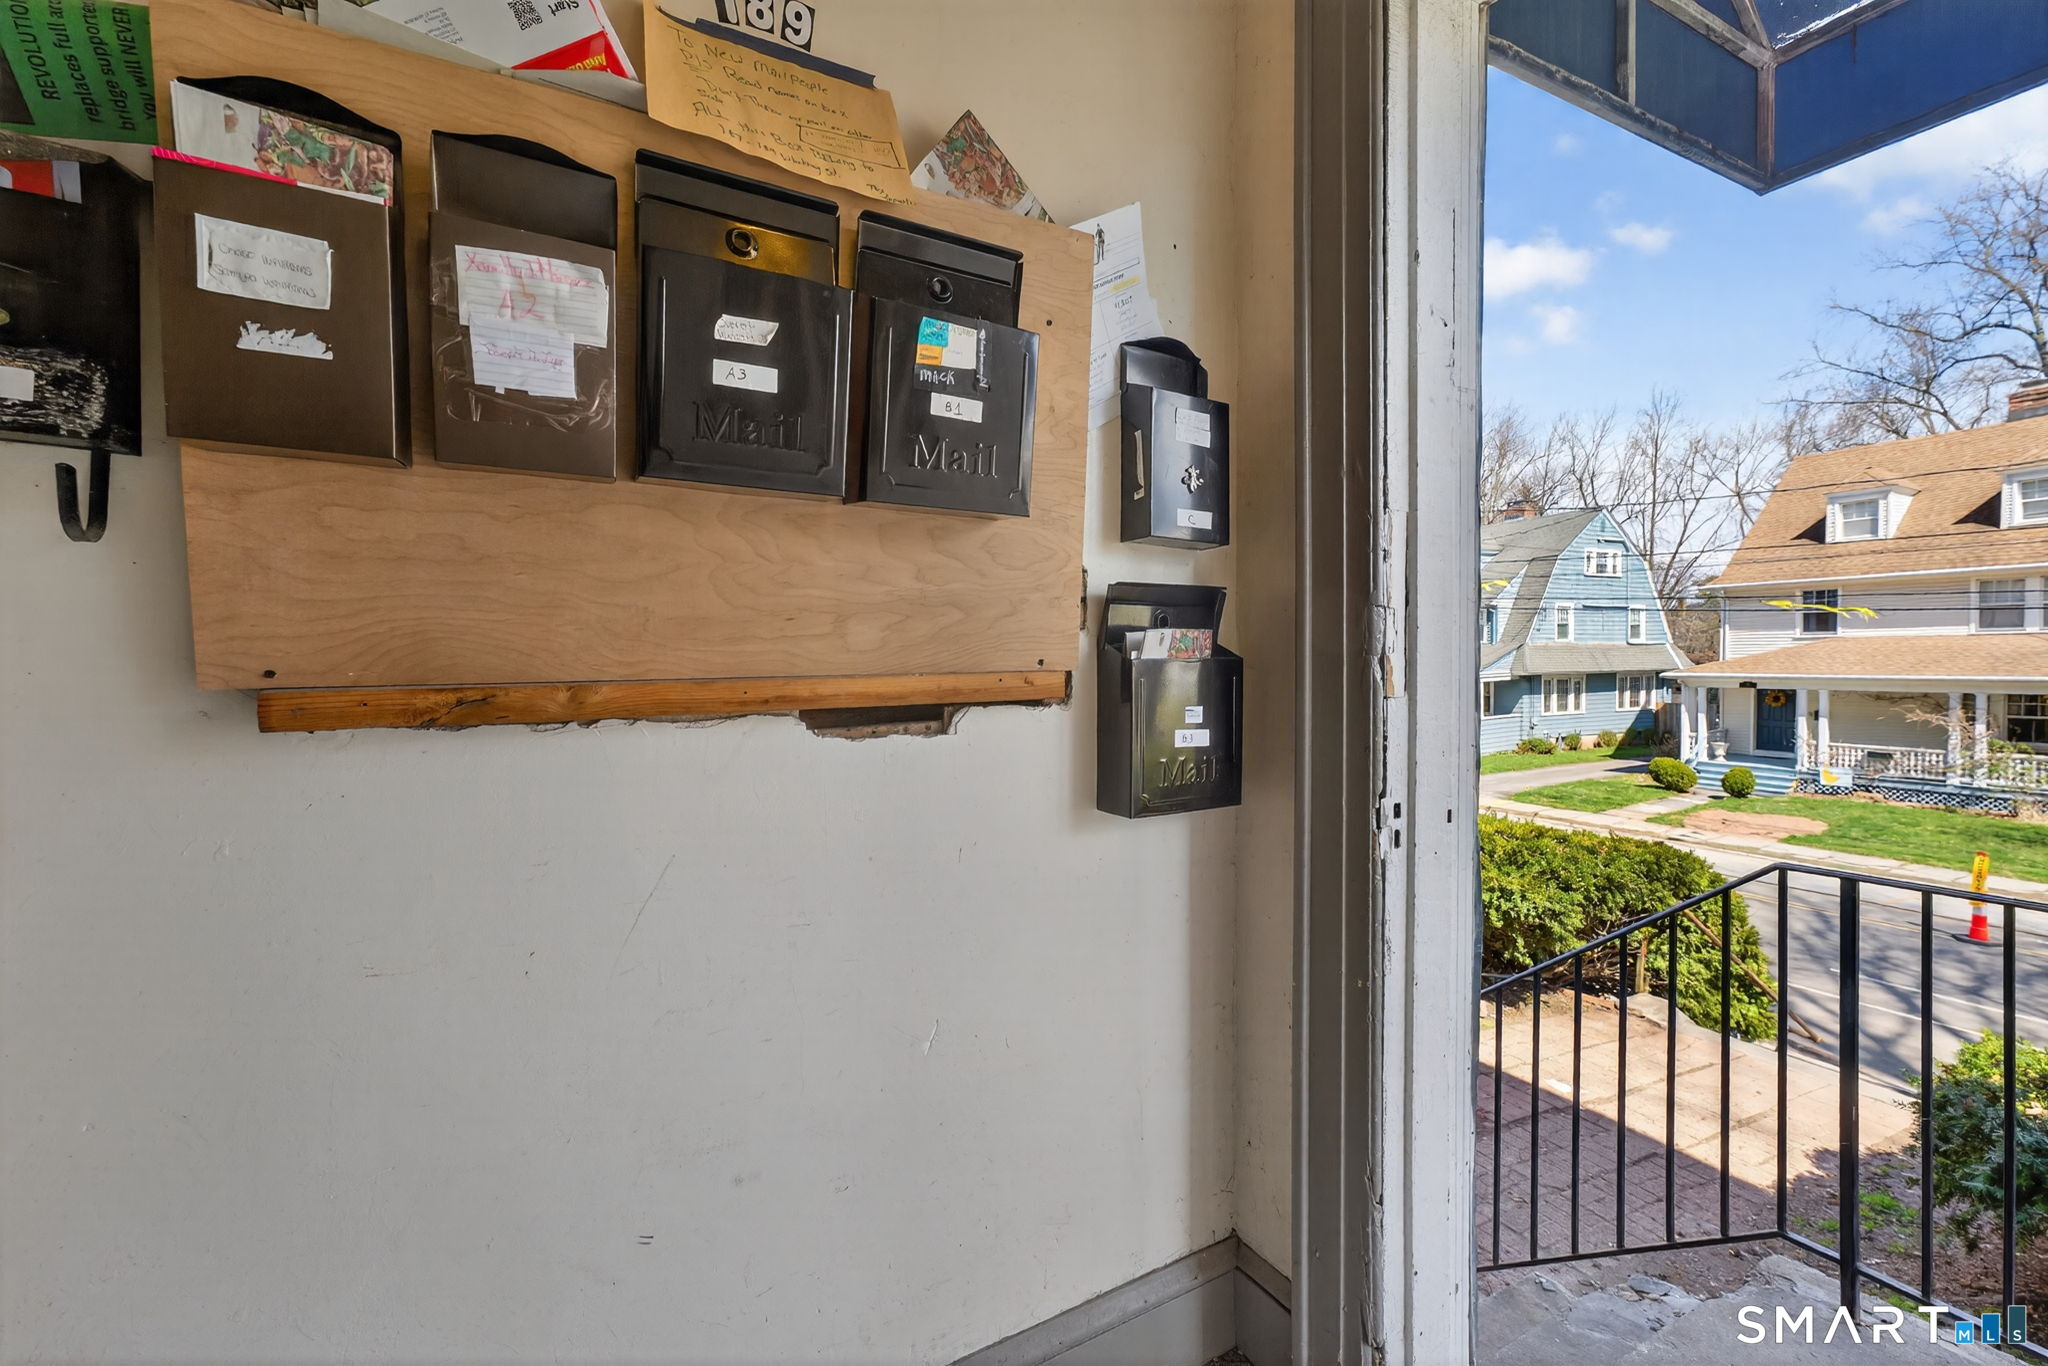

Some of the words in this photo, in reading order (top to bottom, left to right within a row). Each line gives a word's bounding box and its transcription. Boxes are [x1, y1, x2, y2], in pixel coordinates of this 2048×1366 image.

[9, 0, 61, 101] REVOLUTIO
[48, 21, 73, 49] full
[111, 6, 141, 56] NEVER
[667, 25, 694, 48] To
[704, 43, 743, 63] New
[63, 53, 104, 123] replaces
[123, 60, 147, 88] will
[104, 80, 136, 132] bridge
[725, 366, 747, 380] A3
[692, 401, 805, 453] Mail
[908, 433, 998, 479] Mail
[1159, 754, 1218, 788] Mail
